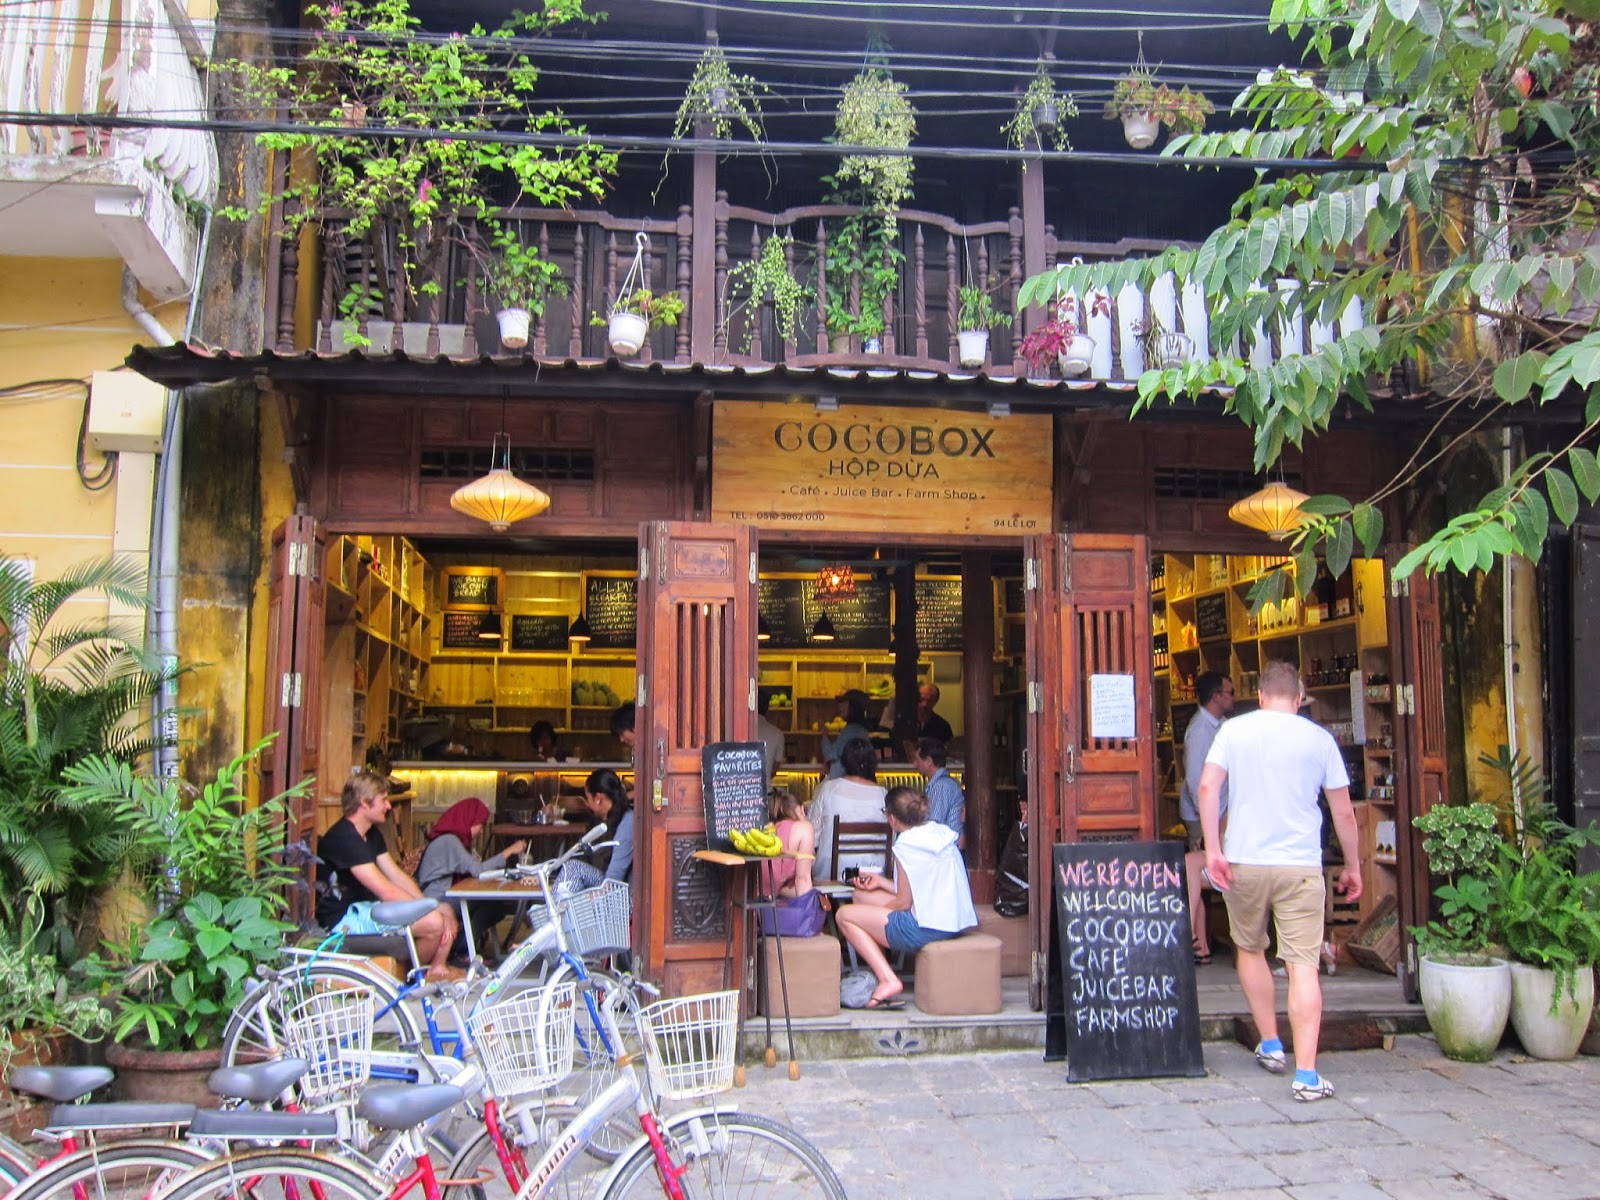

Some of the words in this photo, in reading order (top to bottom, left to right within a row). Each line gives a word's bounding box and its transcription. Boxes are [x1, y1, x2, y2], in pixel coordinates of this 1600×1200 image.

[774, 421, 996, 458] COCOBOX
[789, 484, 820, 496] Café
[832, 485, 867, 497] Juice
[871, 487, 893, 498] Bar
[906, 488, 940, 499] Farm
[944, 489, 977, 501] Shop
[805, 512, 825, 523] 000
[993, 520, 1005, 529] 94
[591, 580, 614, 593] ALL
[616, 580, 634, 592] DAY
[589, 592, 637, 602] BREAKFAST
[717, 751, 758, 760] COCOBOX
[713, 760, 762, 774] FAVORITES
[1059, 857, 1120, 888] WE'RE
[1124, 860, 1182, 890] OPEN
[1062, 889, 1160, 914] WELCOME
[1160, 896, 1186, 914] TO
[1066, 915, 1178, 948] COCOBOX
